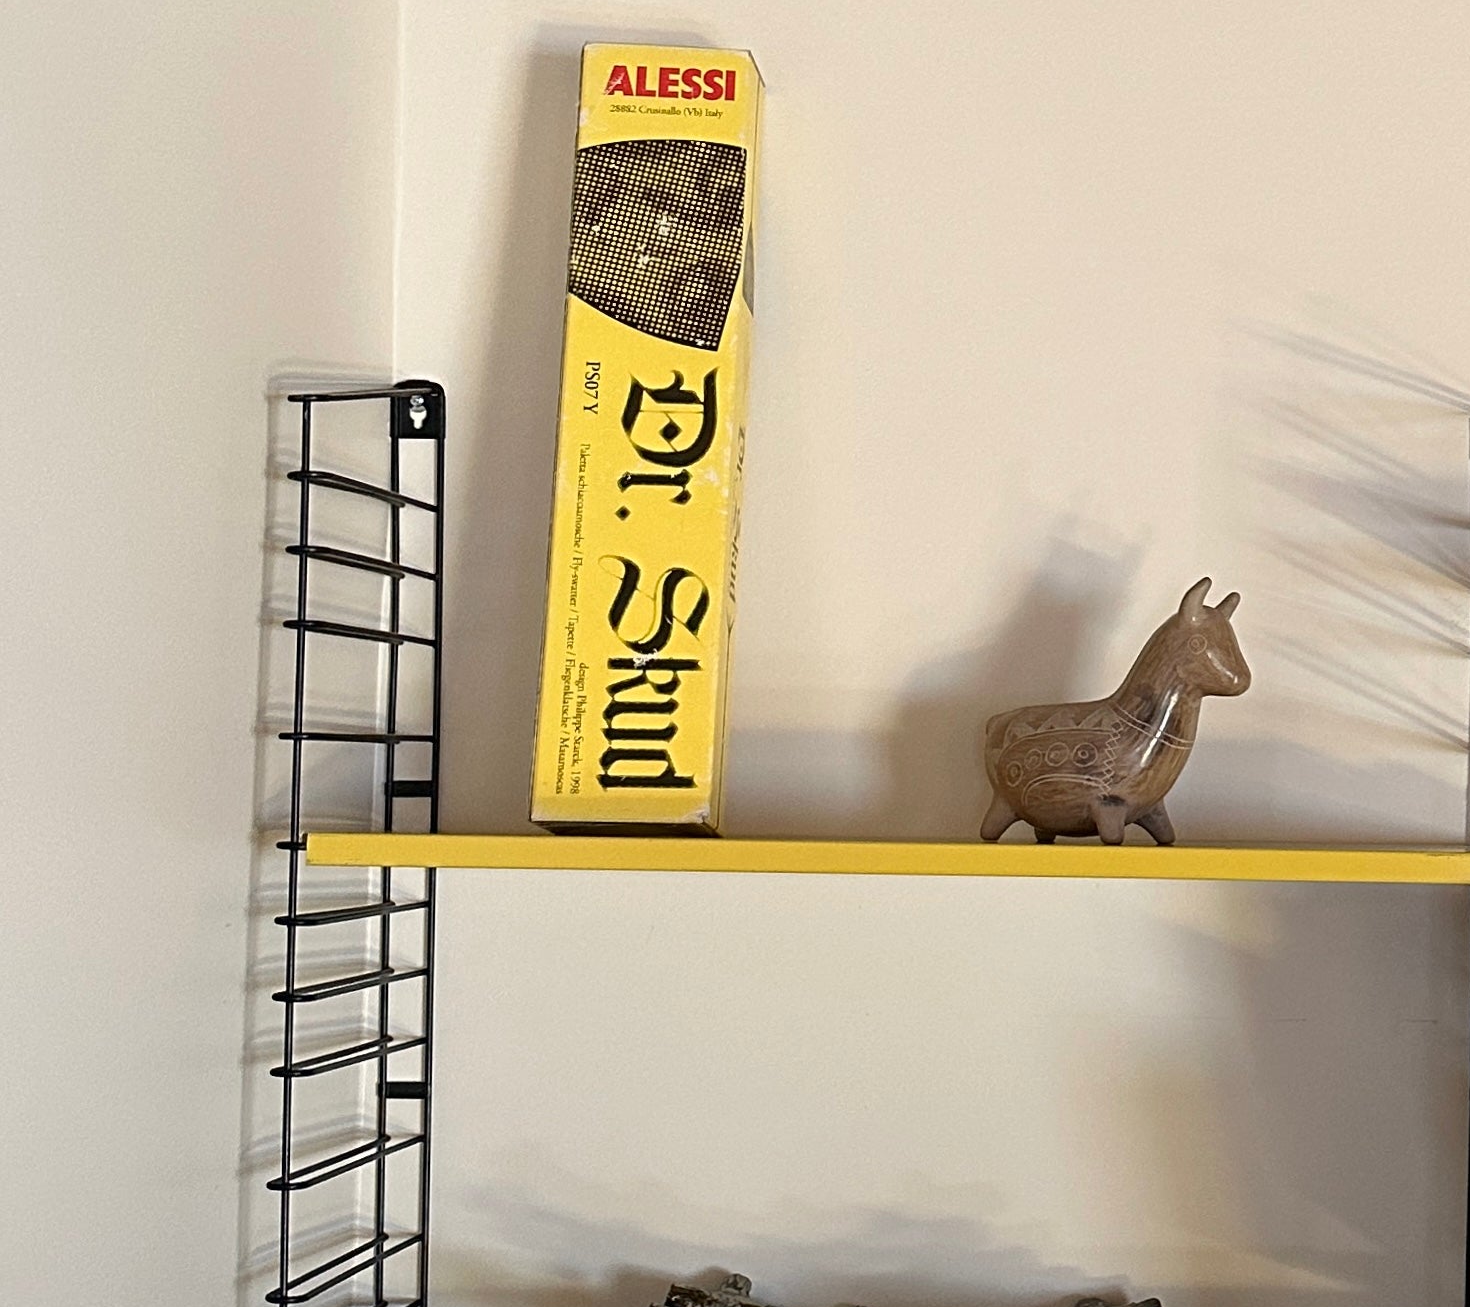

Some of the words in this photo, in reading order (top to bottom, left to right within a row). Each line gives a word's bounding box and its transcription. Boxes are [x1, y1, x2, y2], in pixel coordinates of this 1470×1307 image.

[605, 65, 736, 101] ALESSI
[683, 106, 703, 118] (Vb)
[704, 109, 723, 119] Italy
[584, 361, 601, 400] PS07
[584, 403, 599, 414] Y
[578, 443, 591, 473] Paletta
[614, 366, 720, 522] Dr.
[565, 616, 579, 650] Tapette
[576, 663, 590, 692] design
[596, 554, 711, 793] Skud
[572, 695, 587, 734] Philippe
[570, 771, 582, 795] 1998
